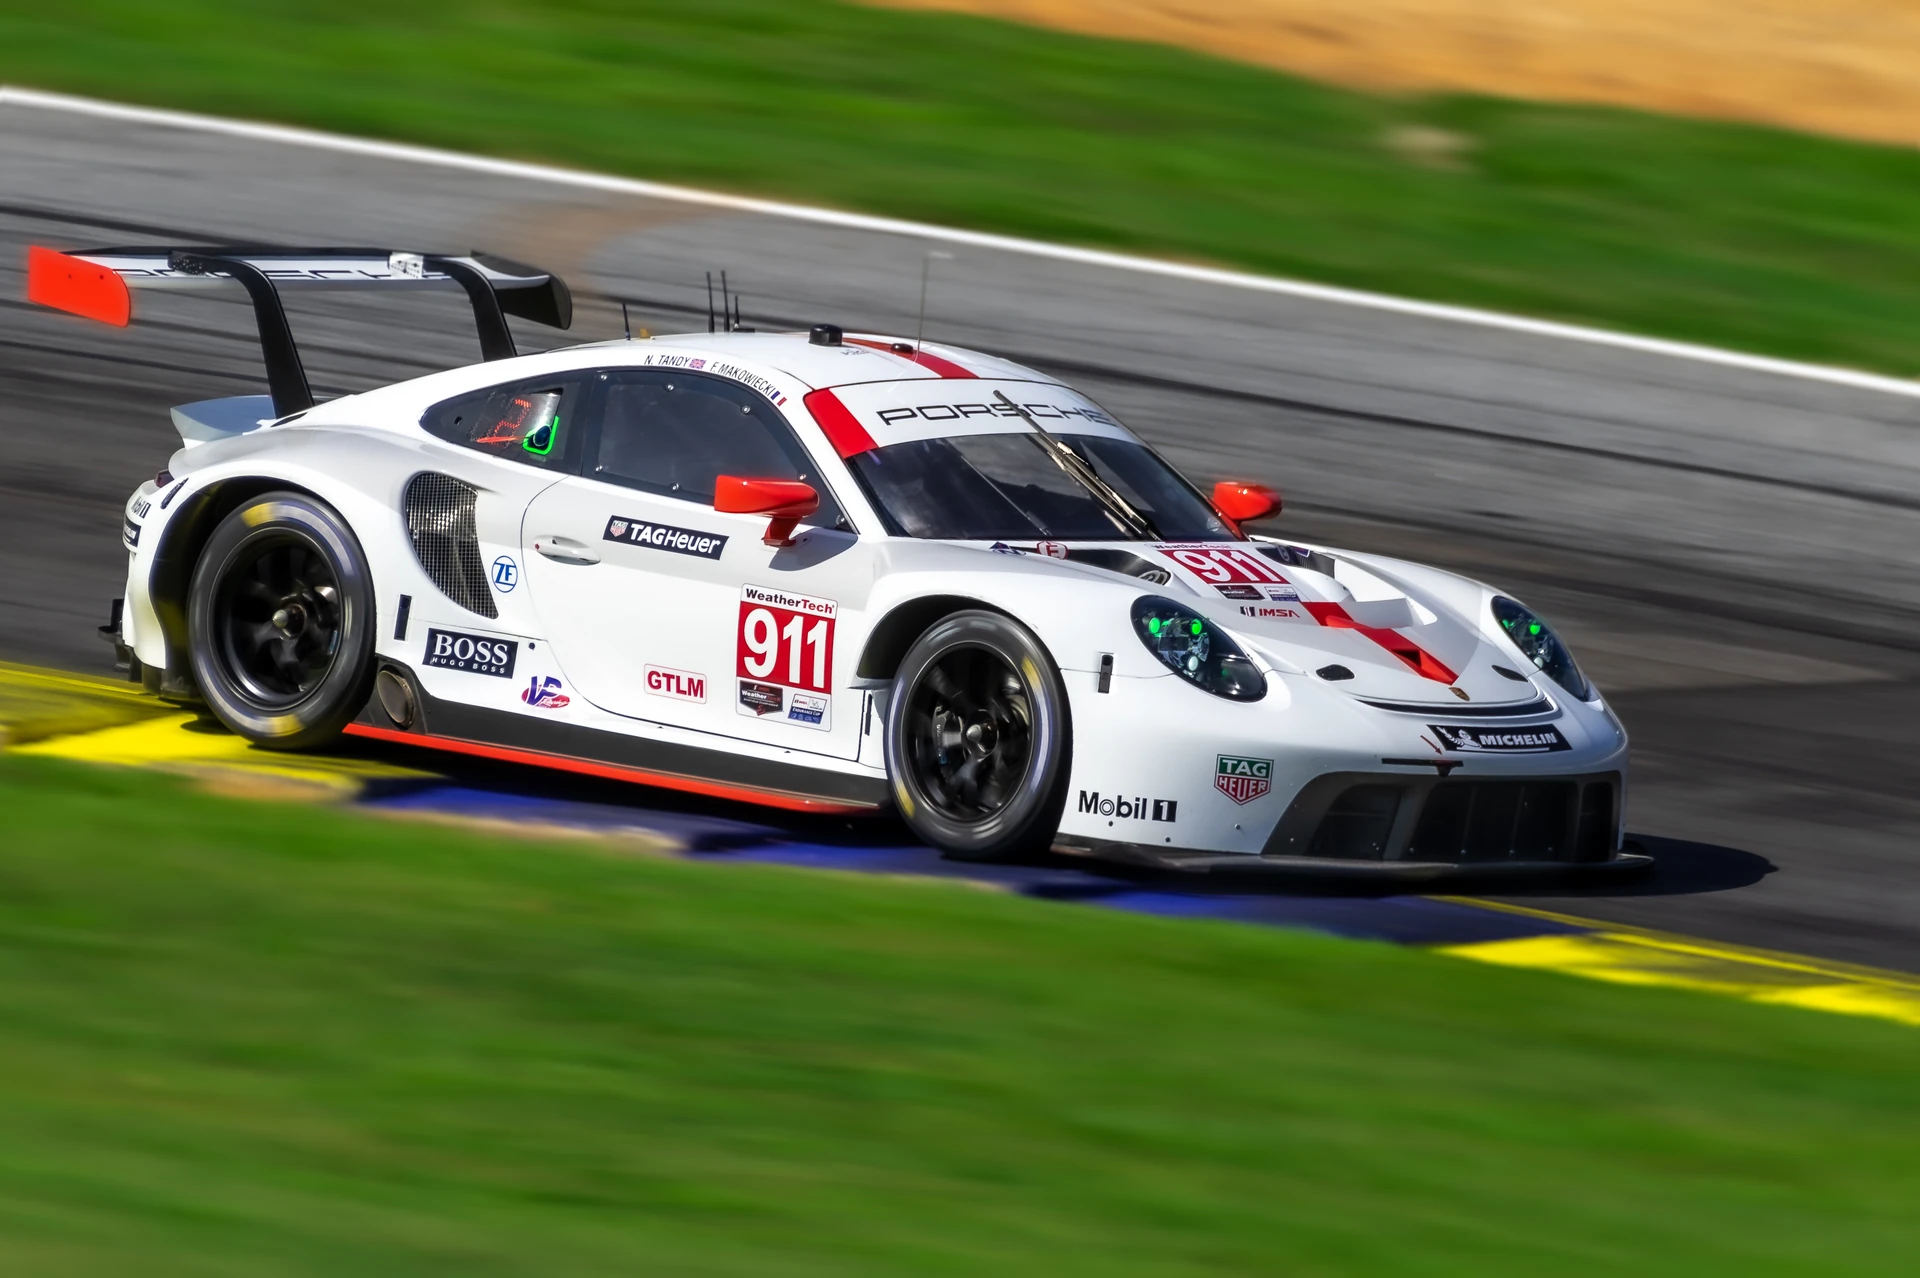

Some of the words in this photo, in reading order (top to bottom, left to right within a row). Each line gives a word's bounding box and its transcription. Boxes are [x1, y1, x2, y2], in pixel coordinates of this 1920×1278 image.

[644, 355, 654, 366] N.
[657, 355, 691, 367] TANDY
[717, 363, 776, 396] MAKOWIECKI
[877, 403, 1118, 426] PORSCHE
[494, 562, 517, 586] ZF
[1172, 550, 1282, 582] 911
[746, 588, 833, 614] WeatherTech
[1259, 608, 1300, 618] IMSA
[433, 634, 508, 666] BOSS
[744, 608, 828, 689] 911
[432, 657, 464, 667] HUGO
[472, 664, 506, 674] BOSS
[647, 670, 704, 698] GTLM
[1479, 732, 1558, 746] MICHELIN
[1222, 759, 1267, 777] TAG
[1218, 777, 1267, 800] HEUER
[1078, 790, 1148, 820] Mobil
